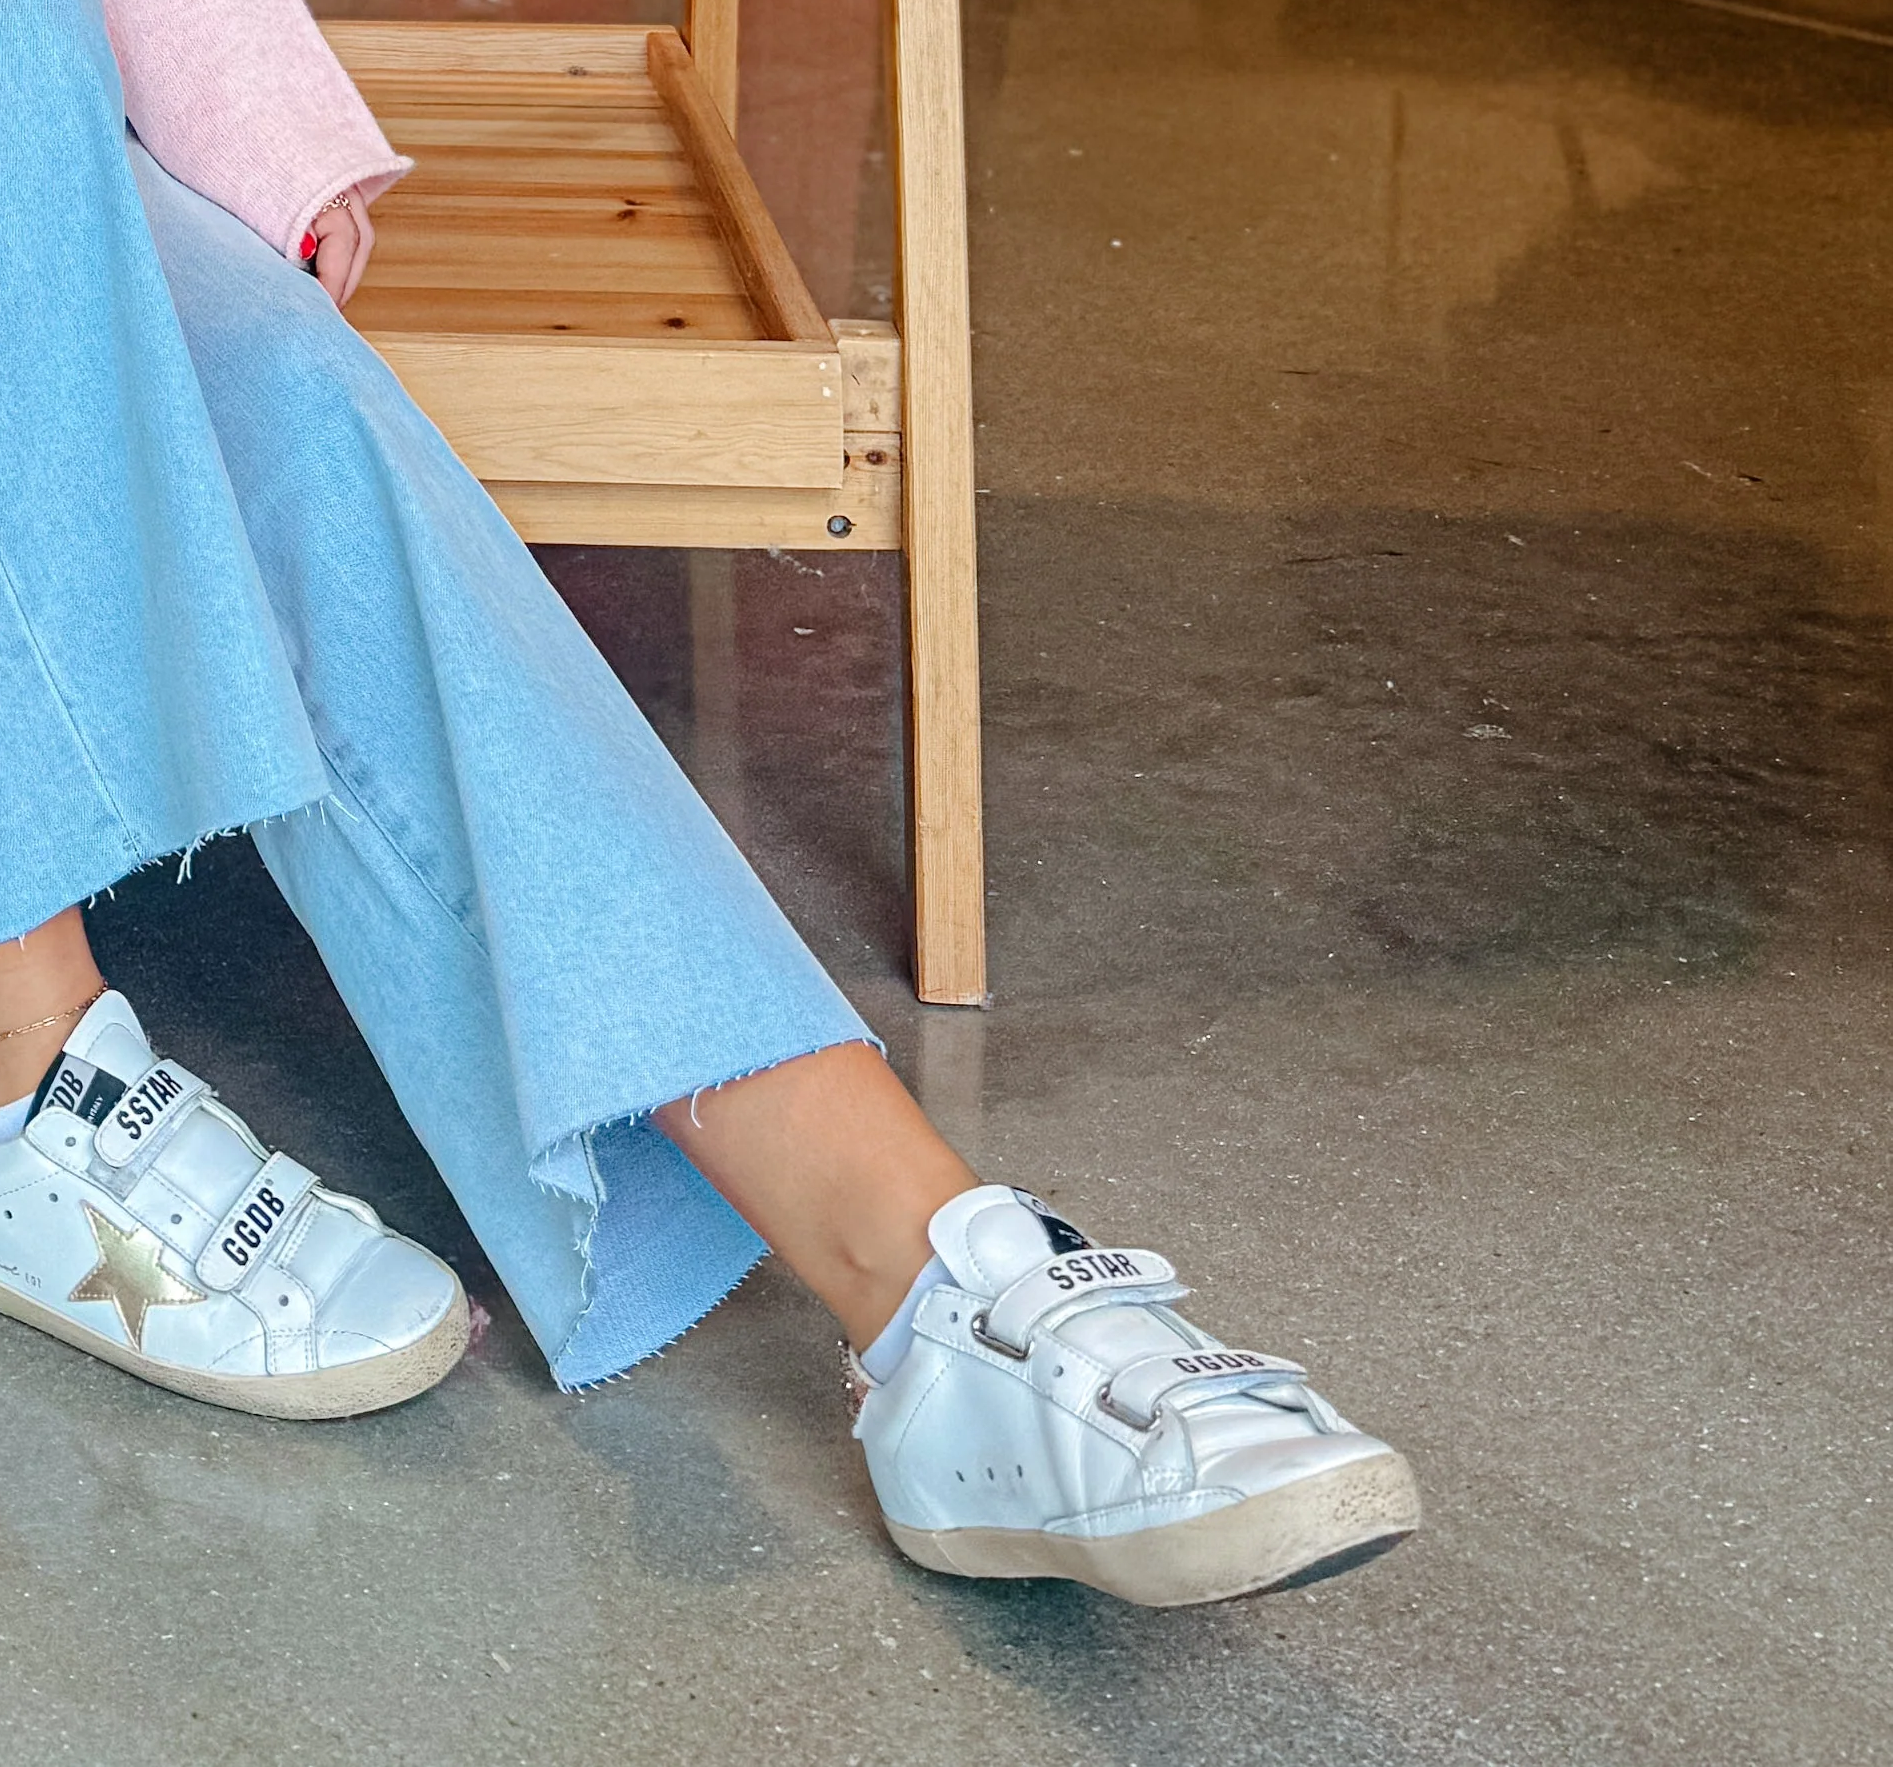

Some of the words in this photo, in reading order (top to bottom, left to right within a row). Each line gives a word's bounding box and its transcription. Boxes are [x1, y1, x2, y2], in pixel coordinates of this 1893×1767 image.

[116, 1068, 183, 1140] SSTAR
[221, 1187, 285, 1266] GGDB
[1047, 1252, 1142, 1290] SSTAR
[1172, 1353, 1266, 1375] GGDB
